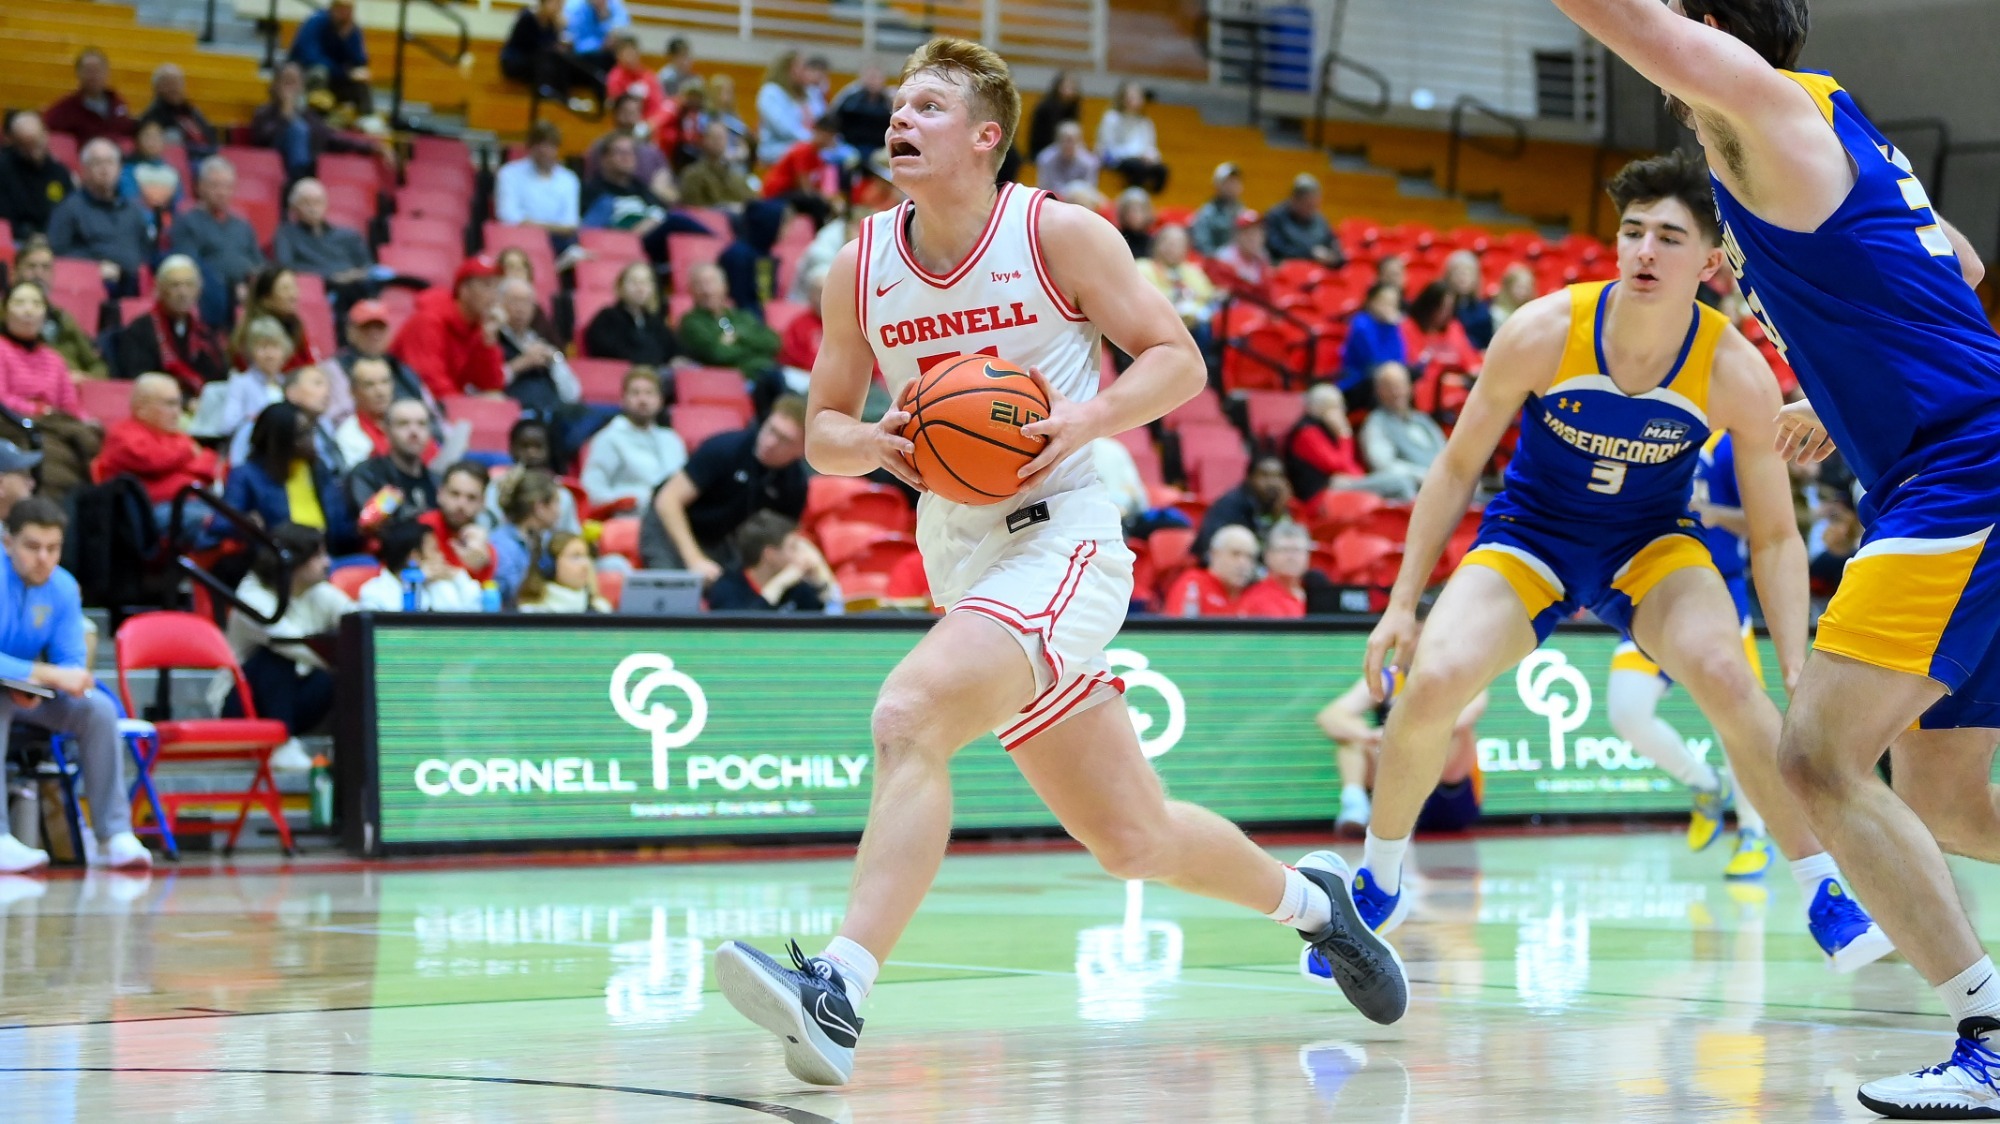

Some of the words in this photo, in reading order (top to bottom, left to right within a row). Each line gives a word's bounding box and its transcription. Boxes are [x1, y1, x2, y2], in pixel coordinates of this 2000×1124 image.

[991, 271, 1011, 283] Ivy
[880, 302, 1038, 348] CORNELL
[990, 400, 1046, 427] ELIT
[1644, 426, 1684, 440] MAC
[1586, 459, 1628, 495] 3
[414, 756, 638, 796] CORNELL
[686, 753, 869, 791] POCHILY
